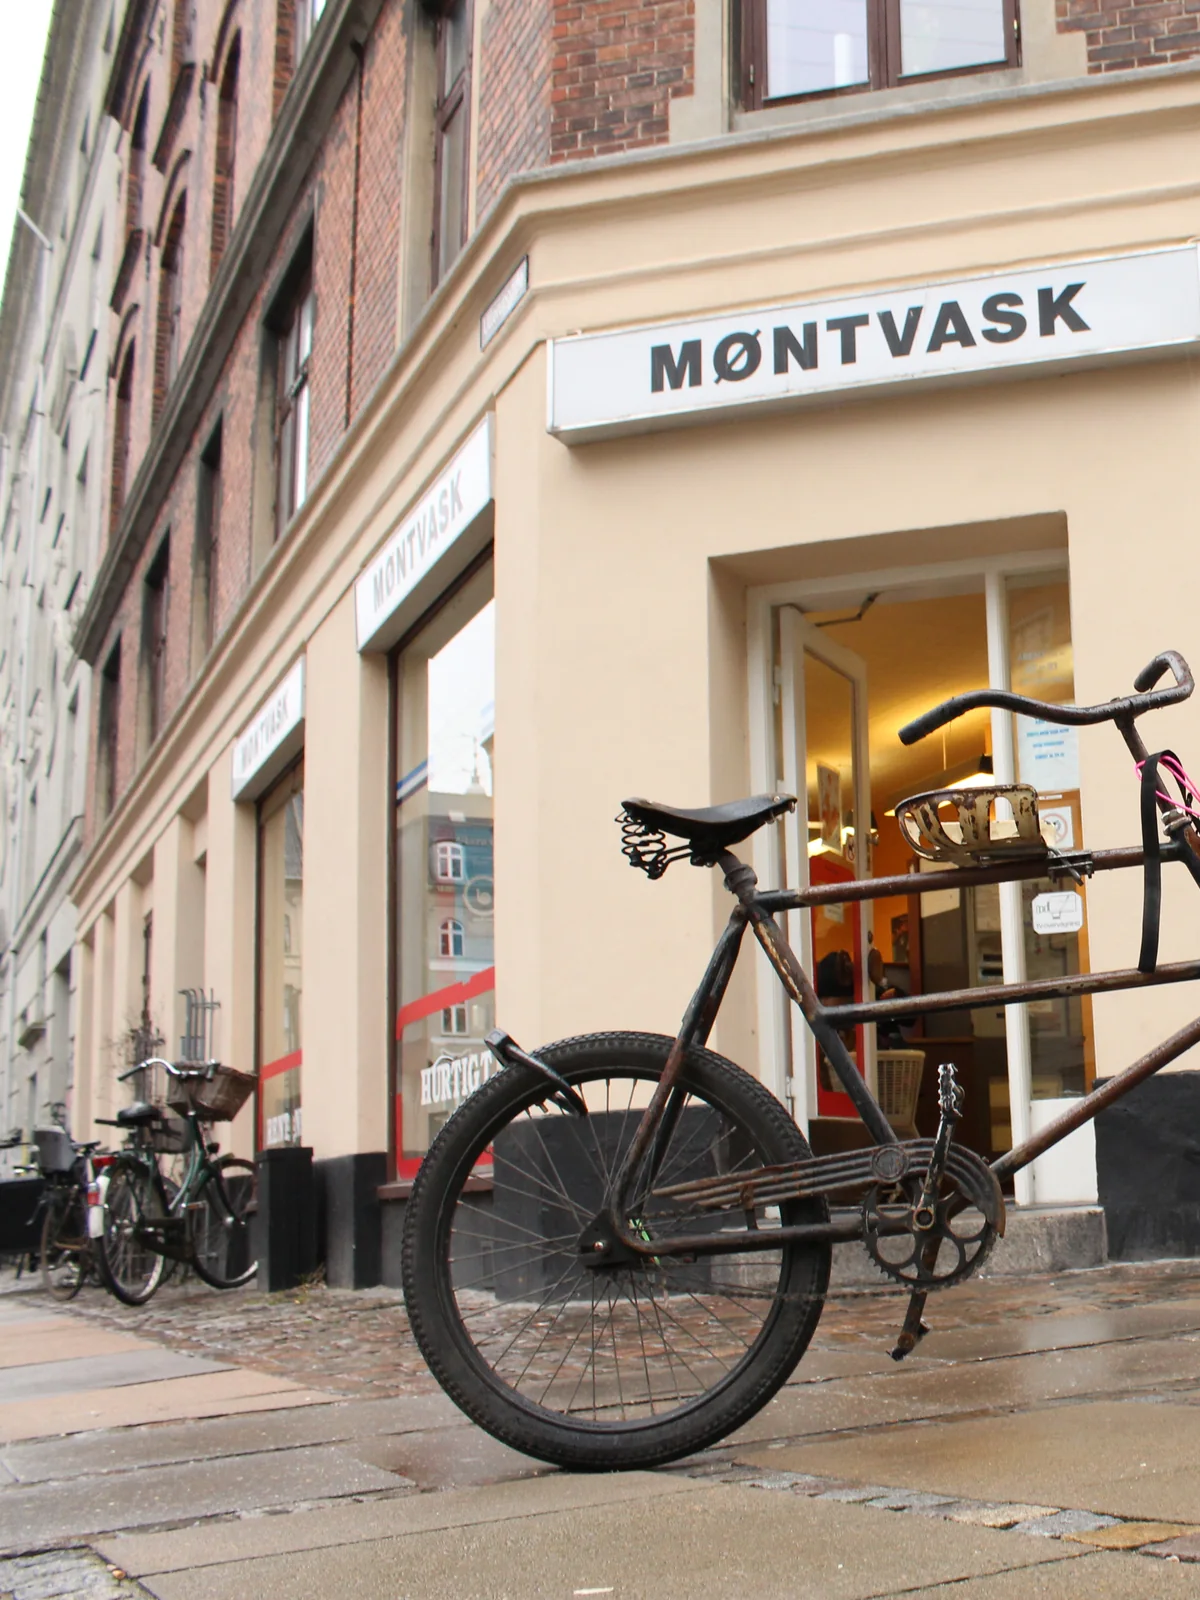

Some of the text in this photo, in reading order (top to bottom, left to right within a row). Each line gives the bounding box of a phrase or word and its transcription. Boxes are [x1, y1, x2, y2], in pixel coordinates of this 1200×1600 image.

[650, 281, 1091, 393] MØNTVASK
[373, 469, 464, 613] MØNTVASK
[420, 1050, 493, 1106] HURTIGT
